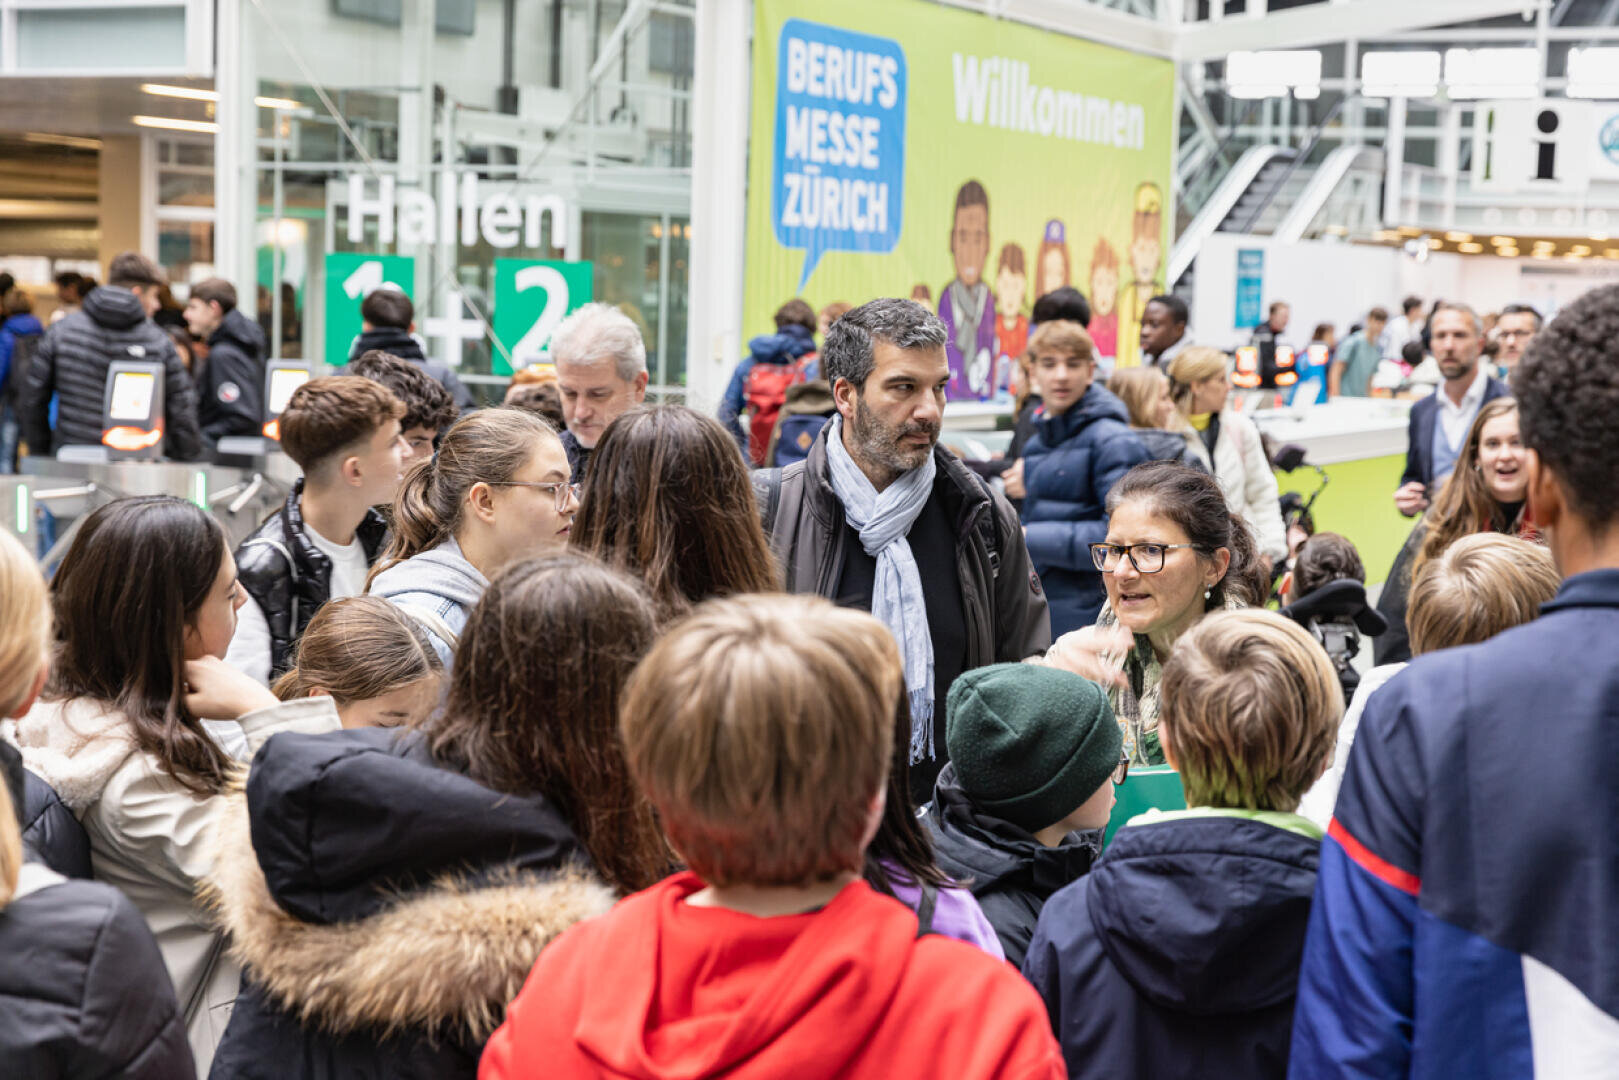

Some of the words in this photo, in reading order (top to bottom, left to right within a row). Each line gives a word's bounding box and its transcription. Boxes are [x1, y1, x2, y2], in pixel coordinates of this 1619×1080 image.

[787, 37, 898, 109] BERUFS
[952, 51, 1145, 151] Willkommen
[785, 104, 880, 169] MESSE
[348, 171, 567, 249] Hallen
[781, 164, 888, 234] ZÜRICH
[511, 265, 569, 369] 2
